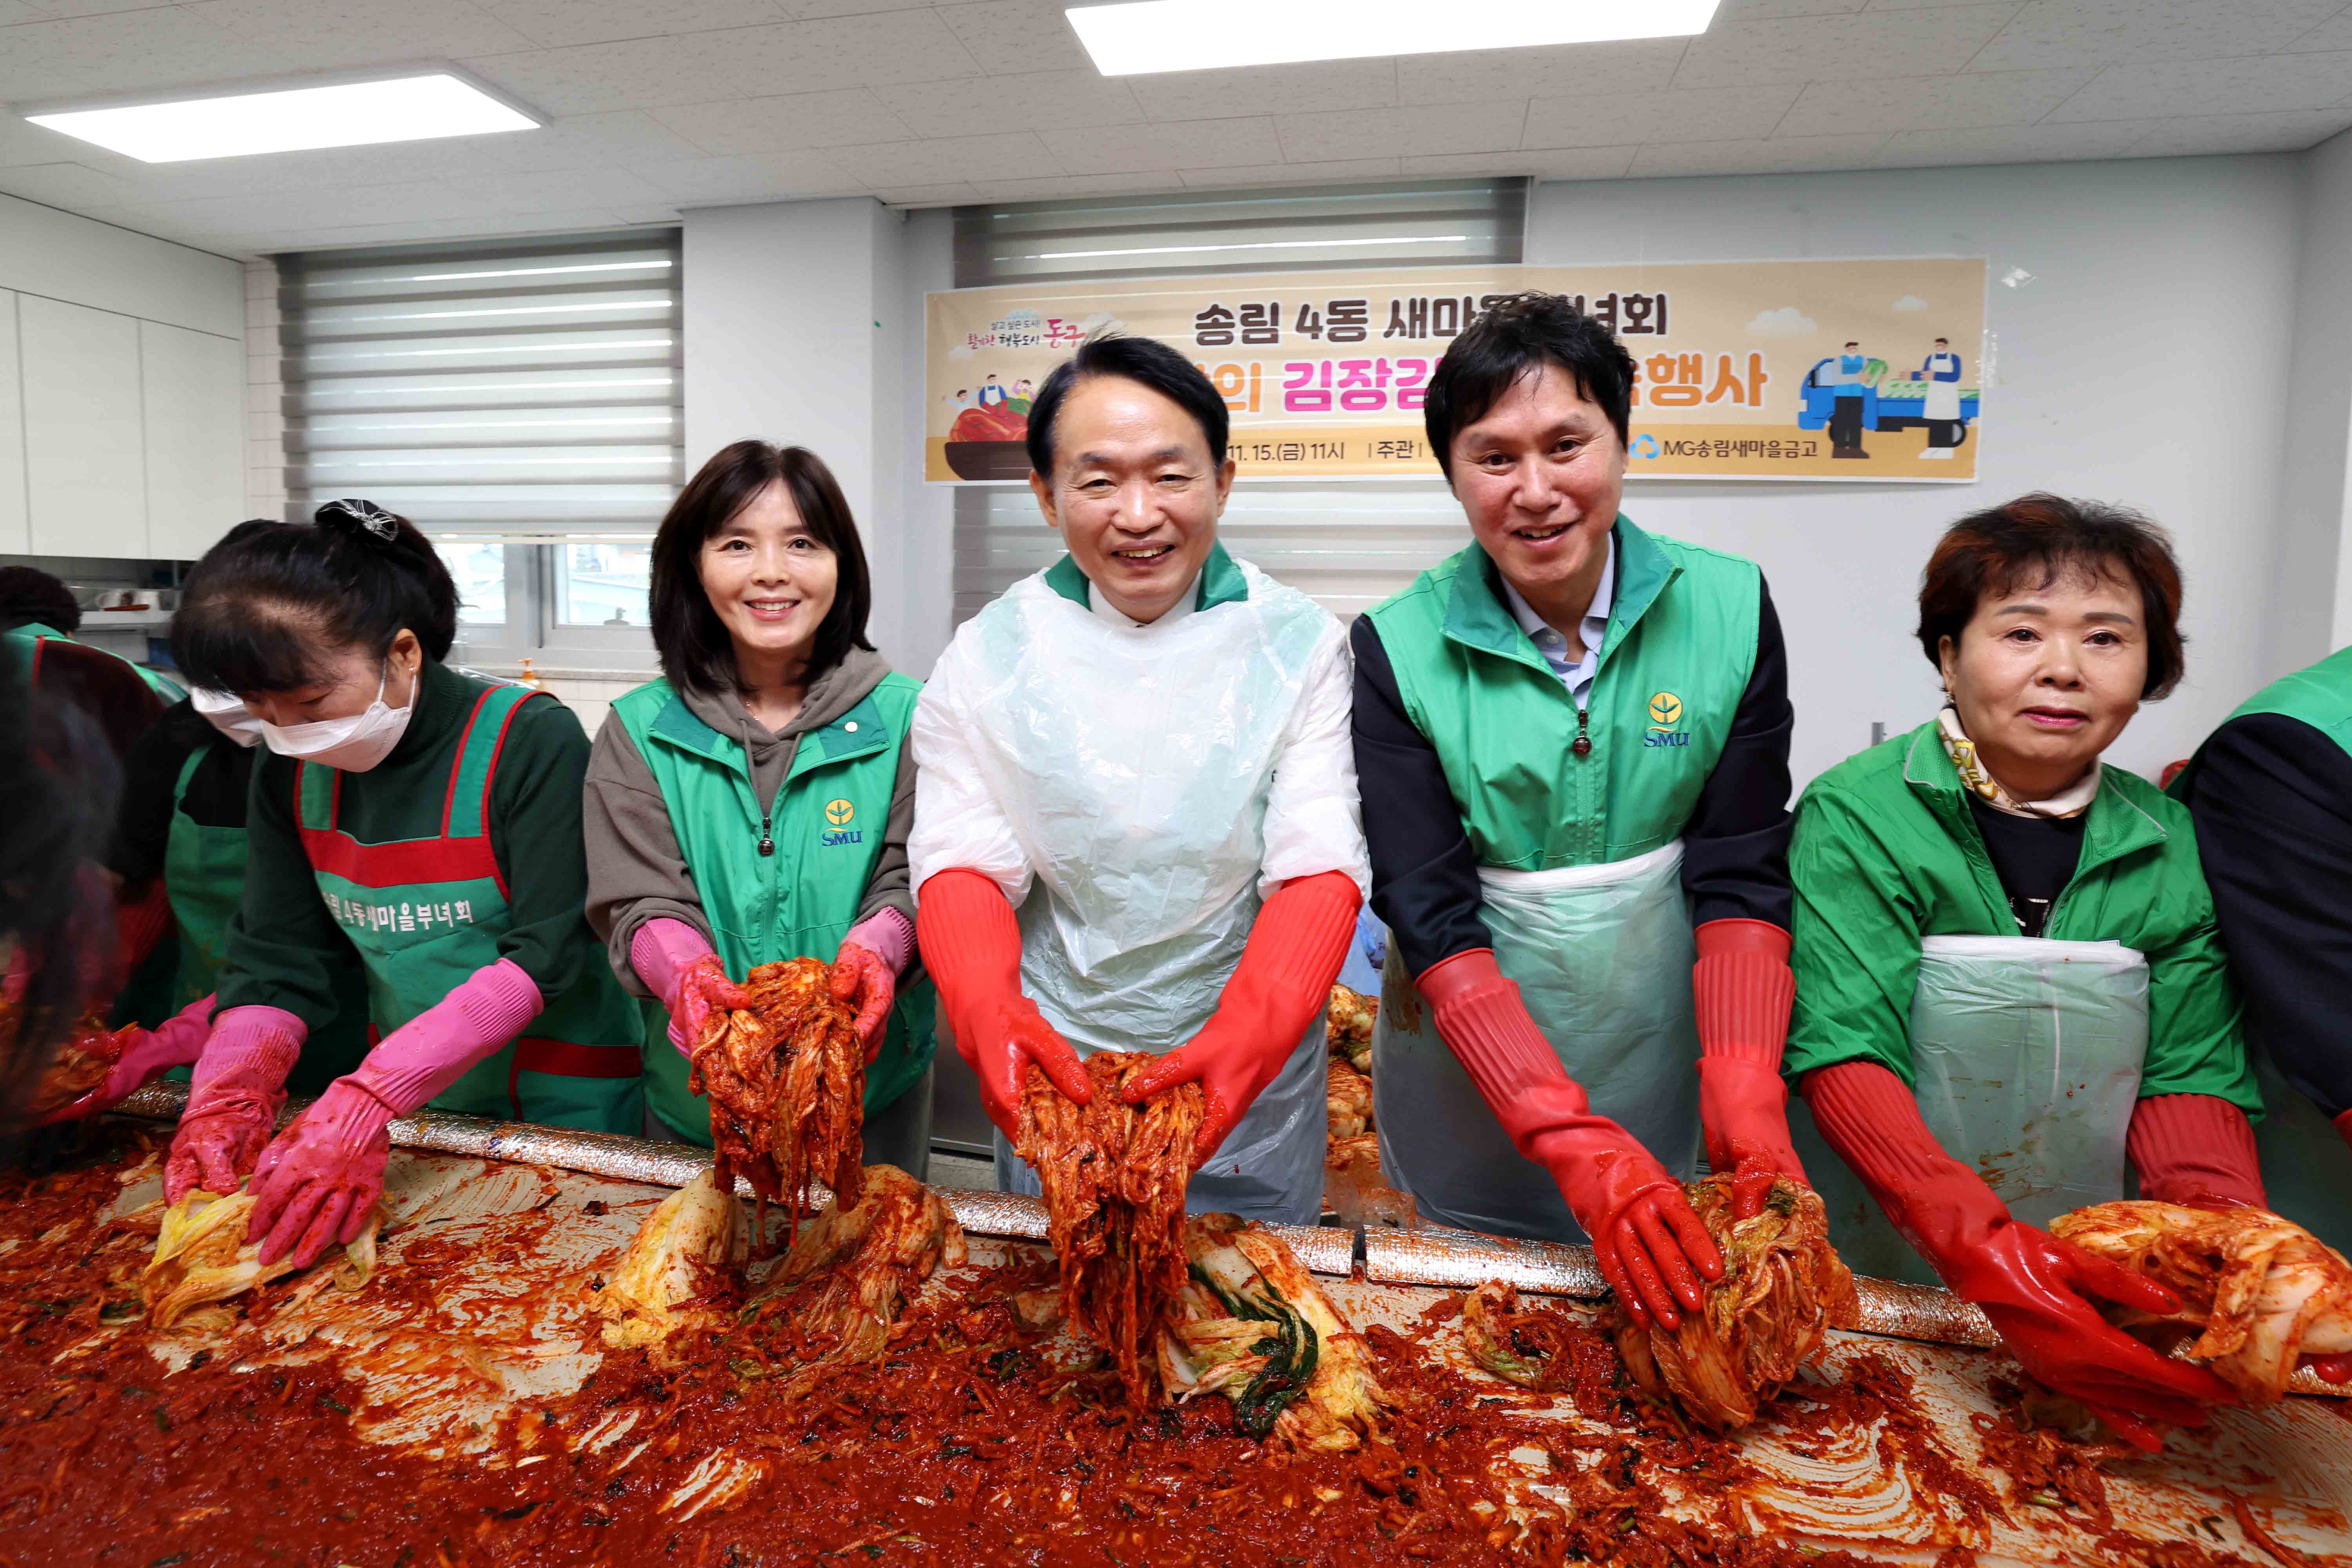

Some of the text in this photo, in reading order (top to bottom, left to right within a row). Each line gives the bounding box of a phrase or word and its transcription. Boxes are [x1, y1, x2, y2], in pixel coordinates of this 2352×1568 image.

[1196, 302, 1279, 346] 송림
[1296, 300, 1368, 342] 4동
[1043, 319, 1086, 348] 동구
[1194, 362, 1261, 412] 의
[1310, 442, 1345, 459] 11시
[1377, 440, 1414, 459] 주관
[1663, 439, 1818, 458] MG송림새마을금고
[1644, 732, 1690, 747] SMU
[822, 831, 863, 847] SMU
